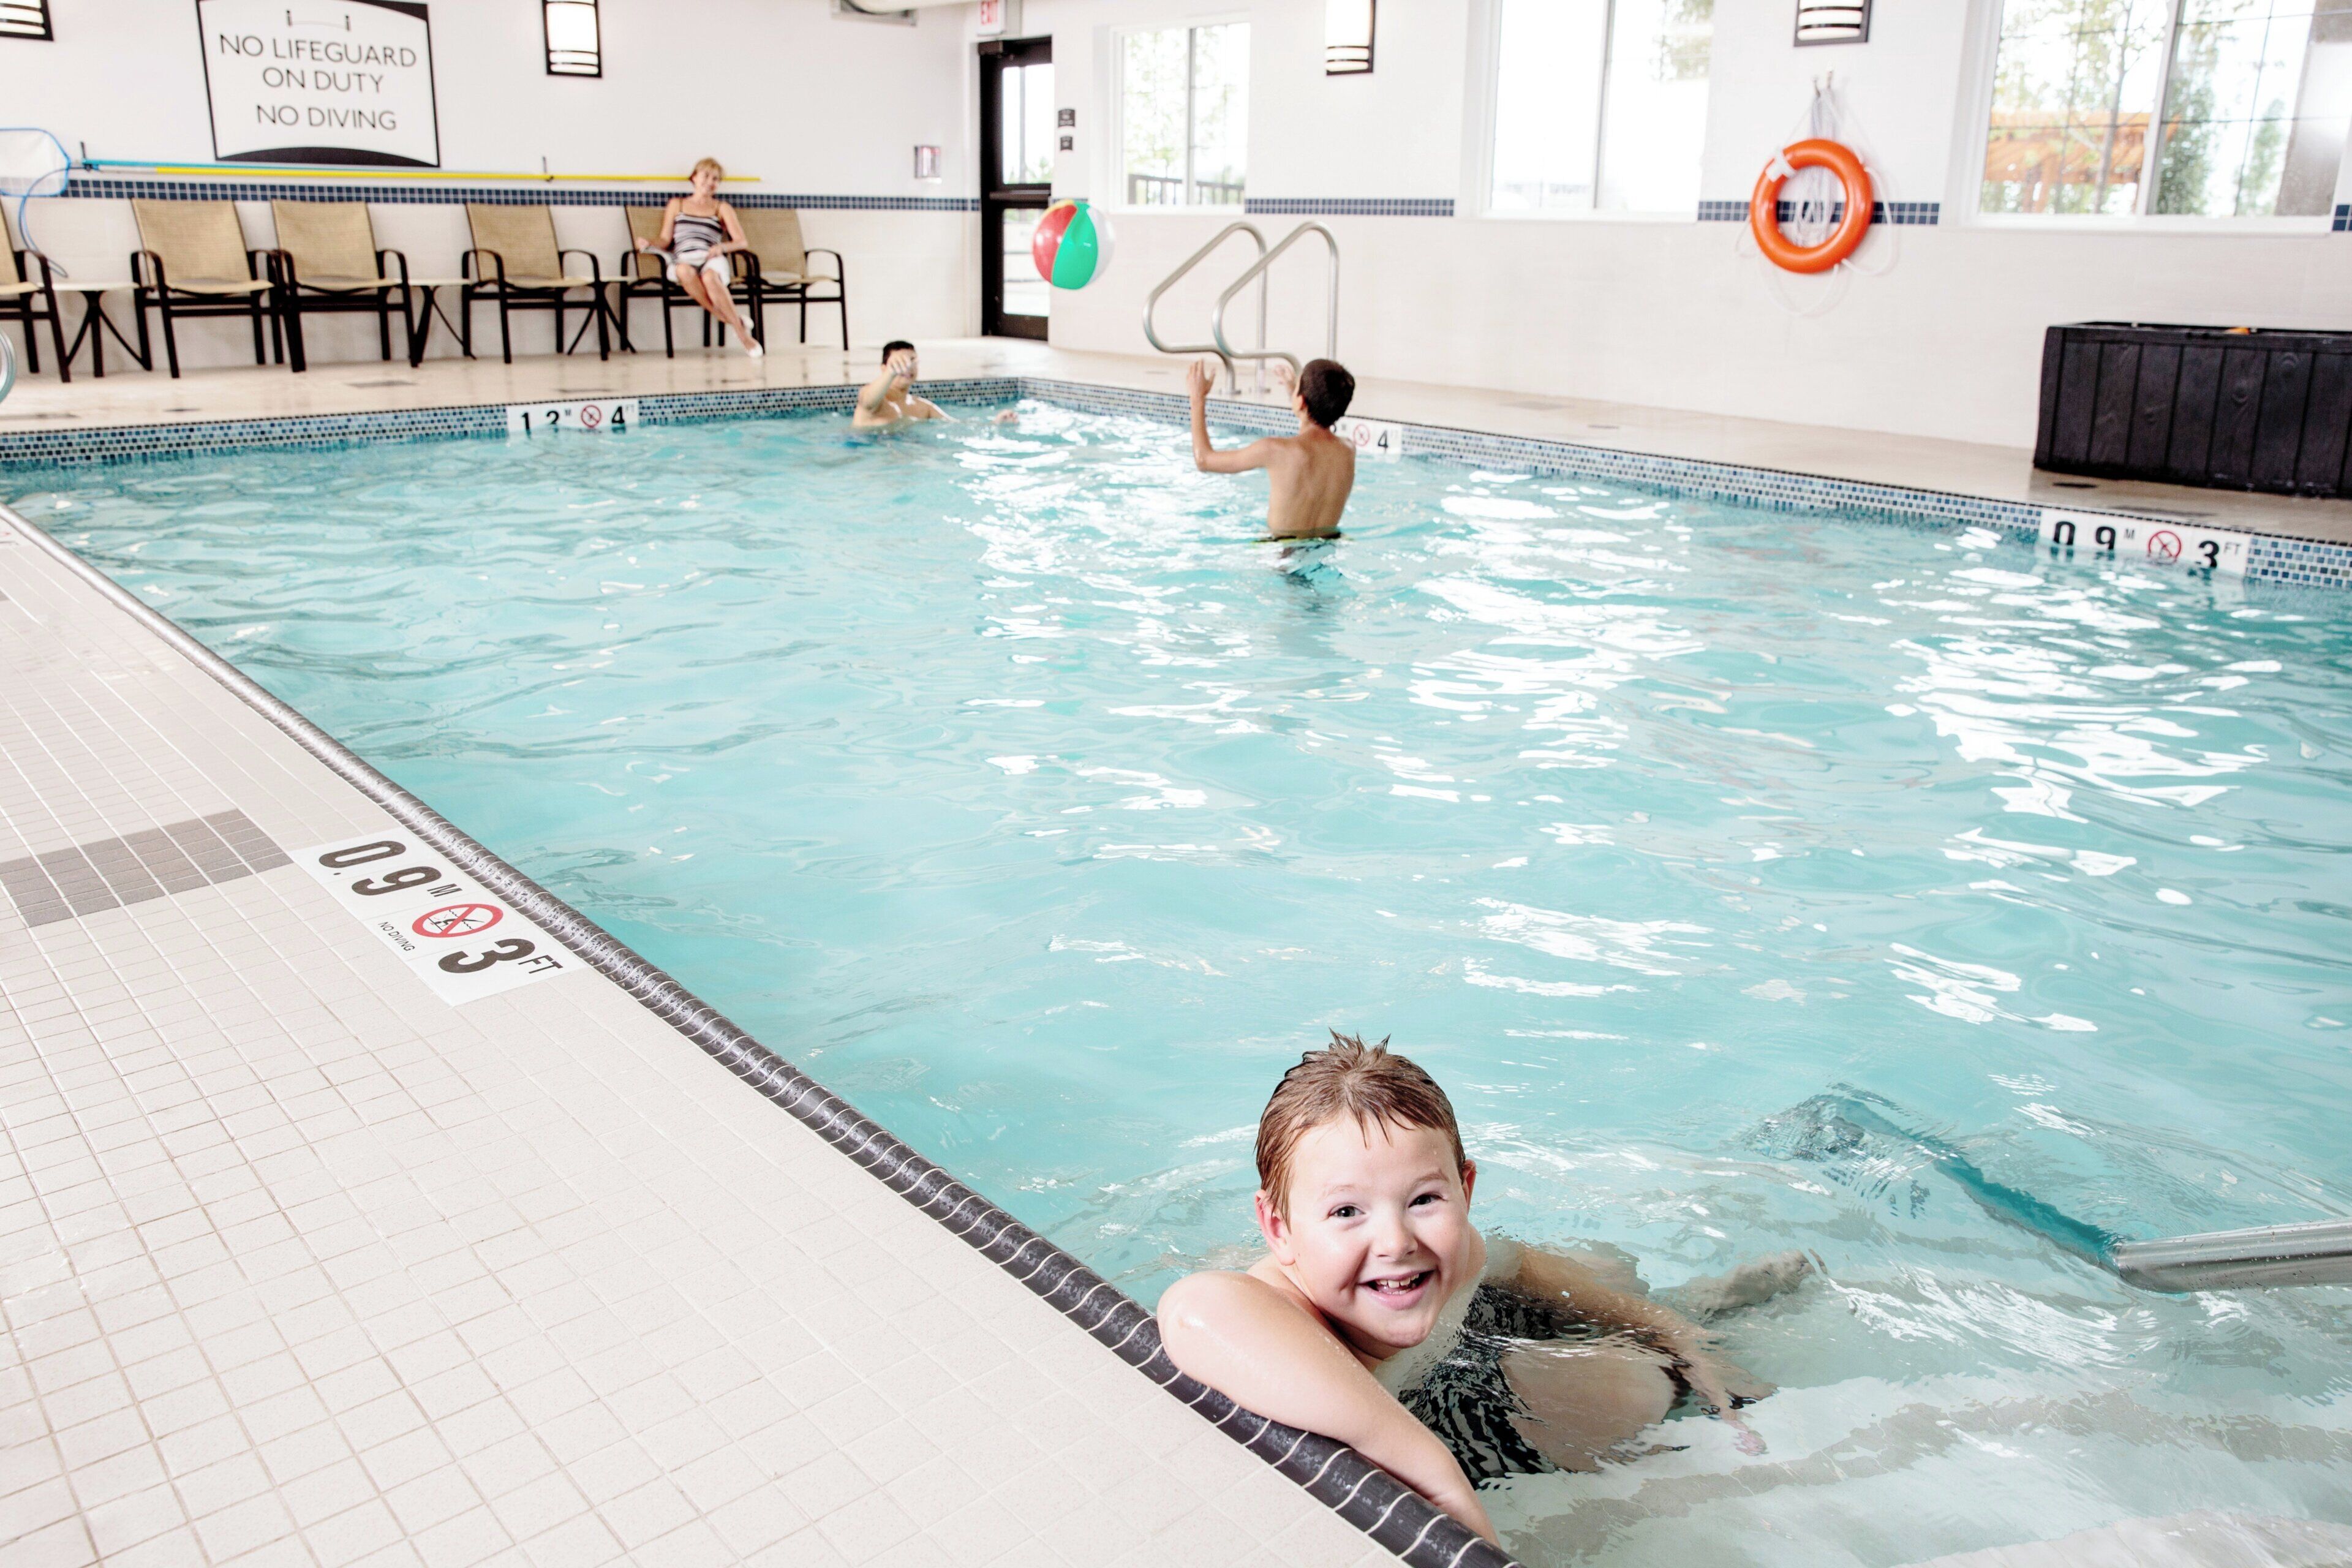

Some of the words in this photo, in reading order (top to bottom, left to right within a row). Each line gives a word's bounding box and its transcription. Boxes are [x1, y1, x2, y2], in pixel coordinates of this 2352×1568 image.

[219, 34, 264, 57] NO
[273, 38, 417, 67] LIFEGUARD
[262, 67, 306, 89] ON
[314, 70, 384, 92] DUTY
[257, 105, 299, 126] NO
[307, 107, 397, 131] DIVING
[1378, 430, 1389, 448] 4
[2124, 528, 2136, 540] M
[2196, 540, 2220, 569] 3
[2223, 541, 2242, 555] FT
[427, 883, 463, 898] M
[377, 921, 394, 932] NO
[388, 931, 415, 952] DIVING
[437, 938, 536, 974] 3
[518, 954, 564, 974] FT
